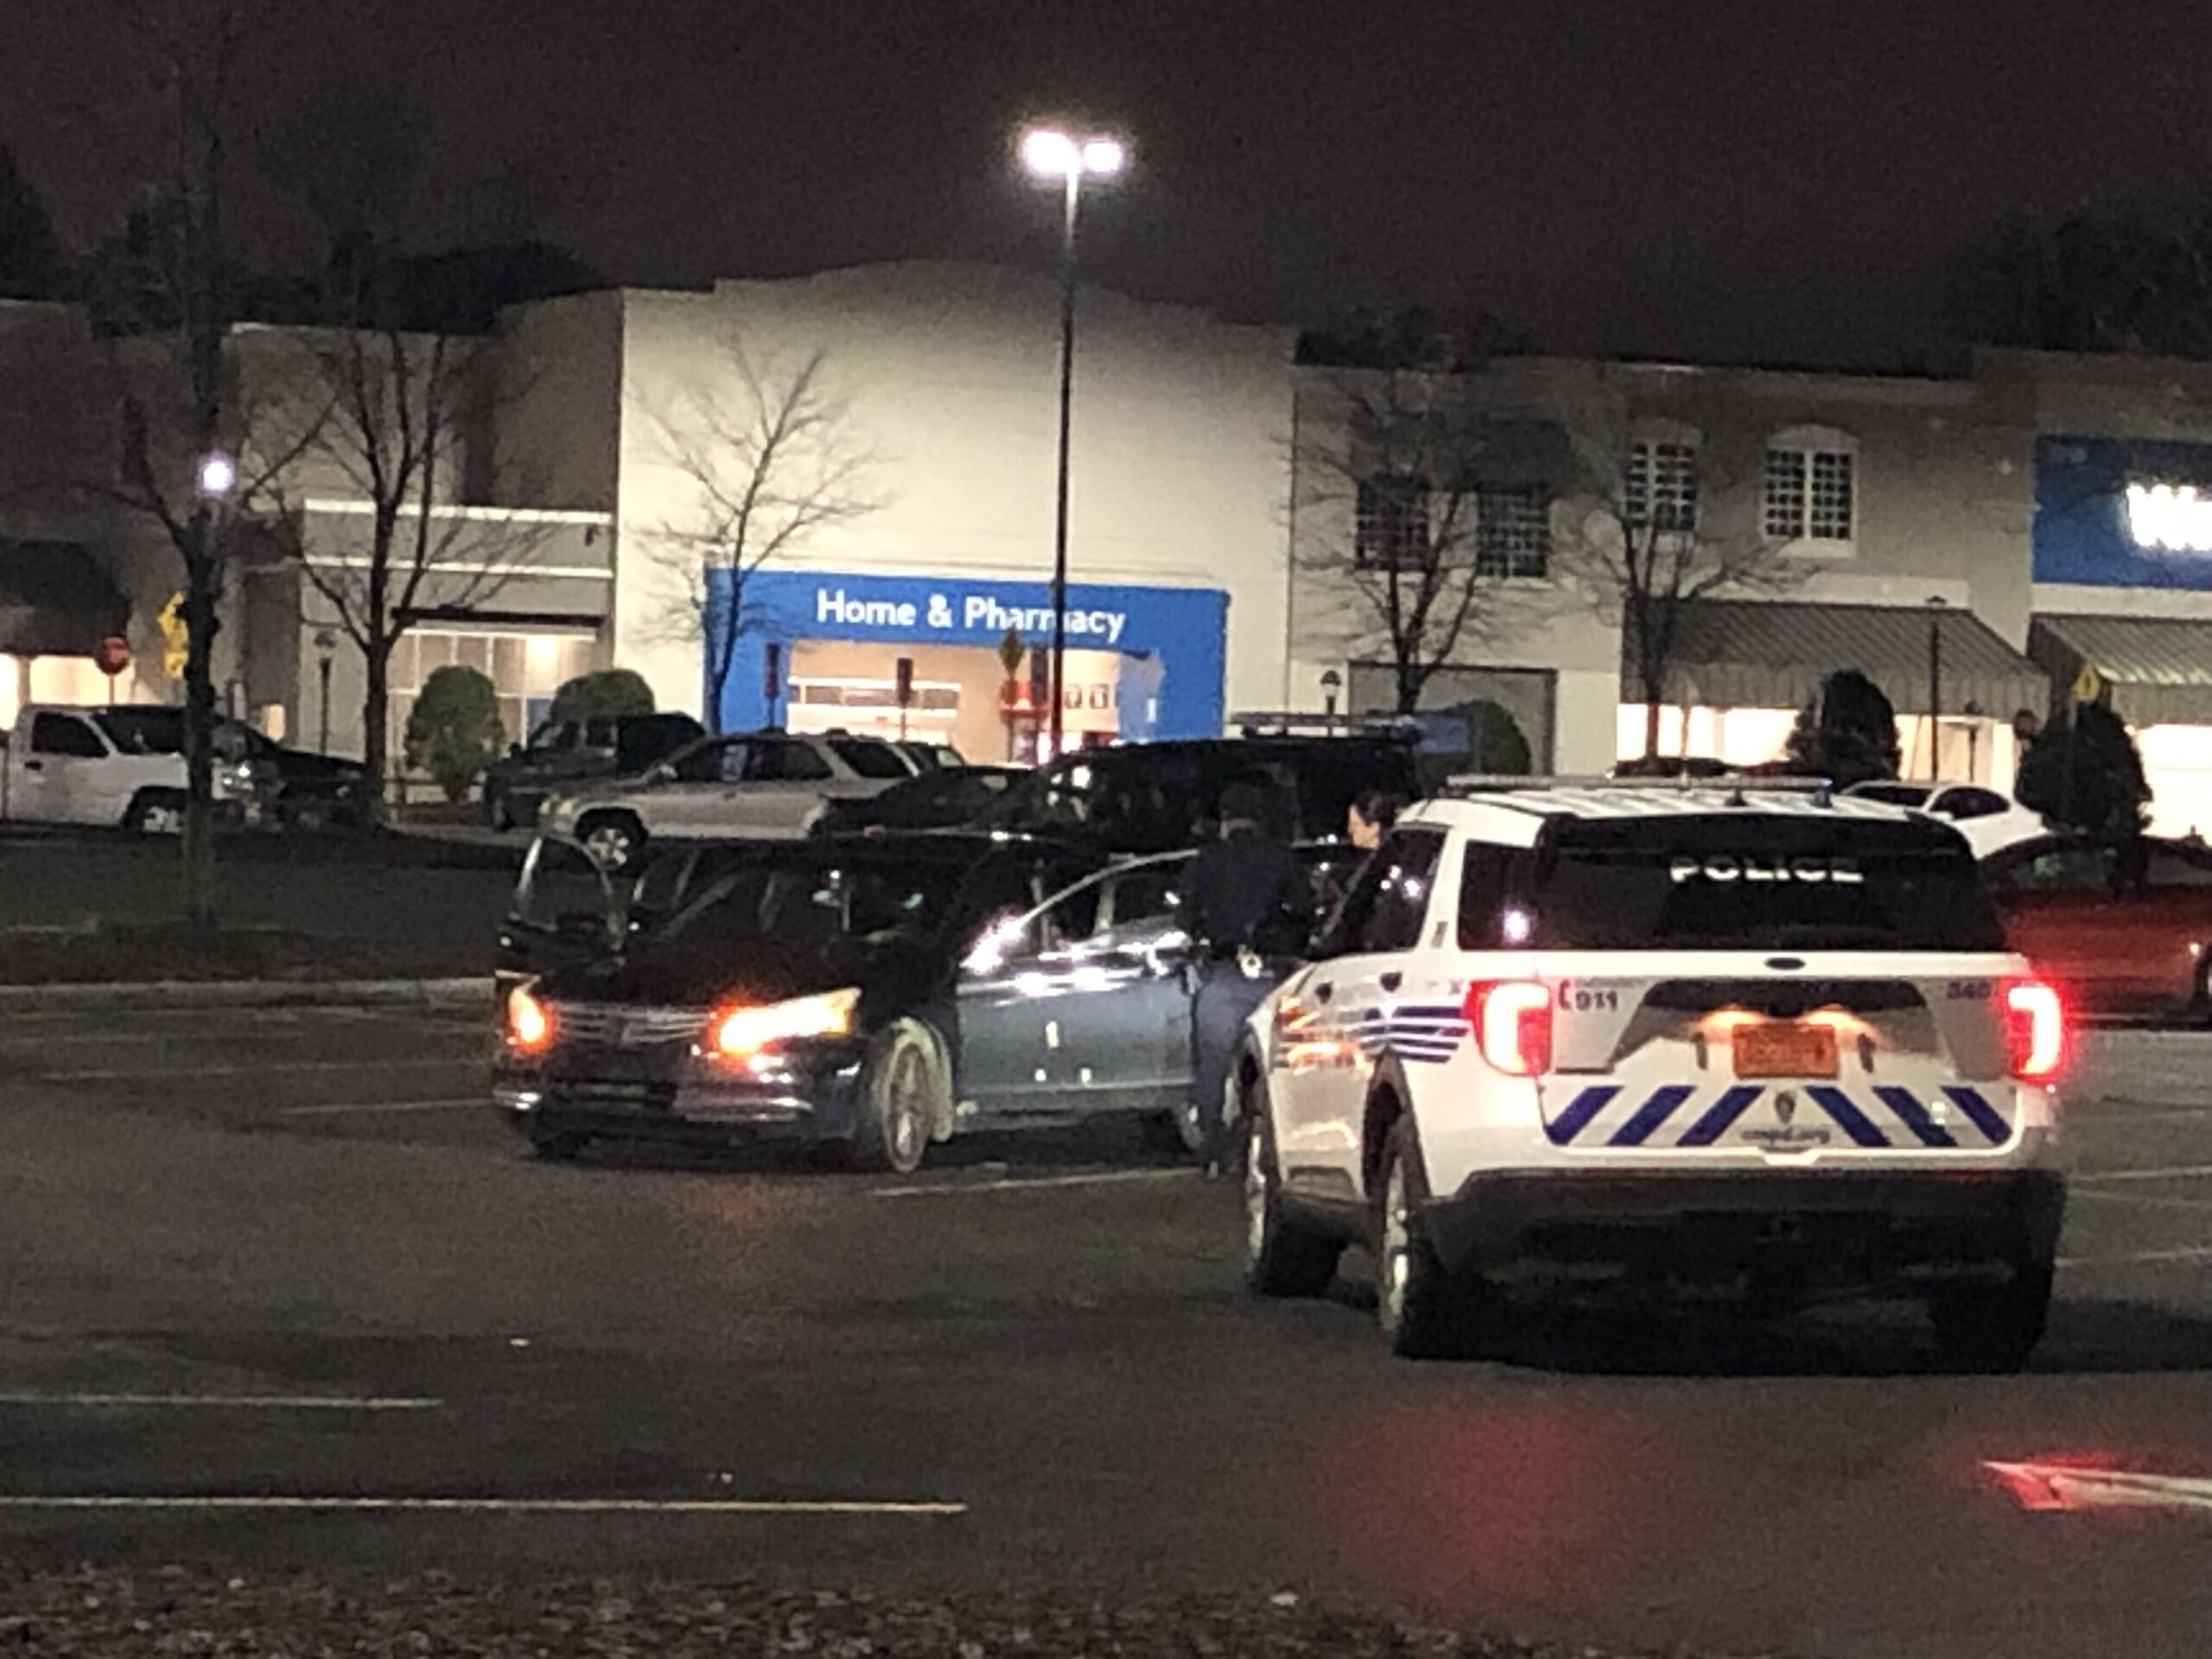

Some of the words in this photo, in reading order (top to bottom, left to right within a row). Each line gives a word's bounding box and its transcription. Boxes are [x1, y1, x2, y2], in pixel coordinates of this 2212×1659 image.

[817, 588, 916, 626] Home
[927, 594, 952, 628] &
[964, 595, 1126, 643] Pharmacy
[1669, 856, 1864, 883] POLICE
